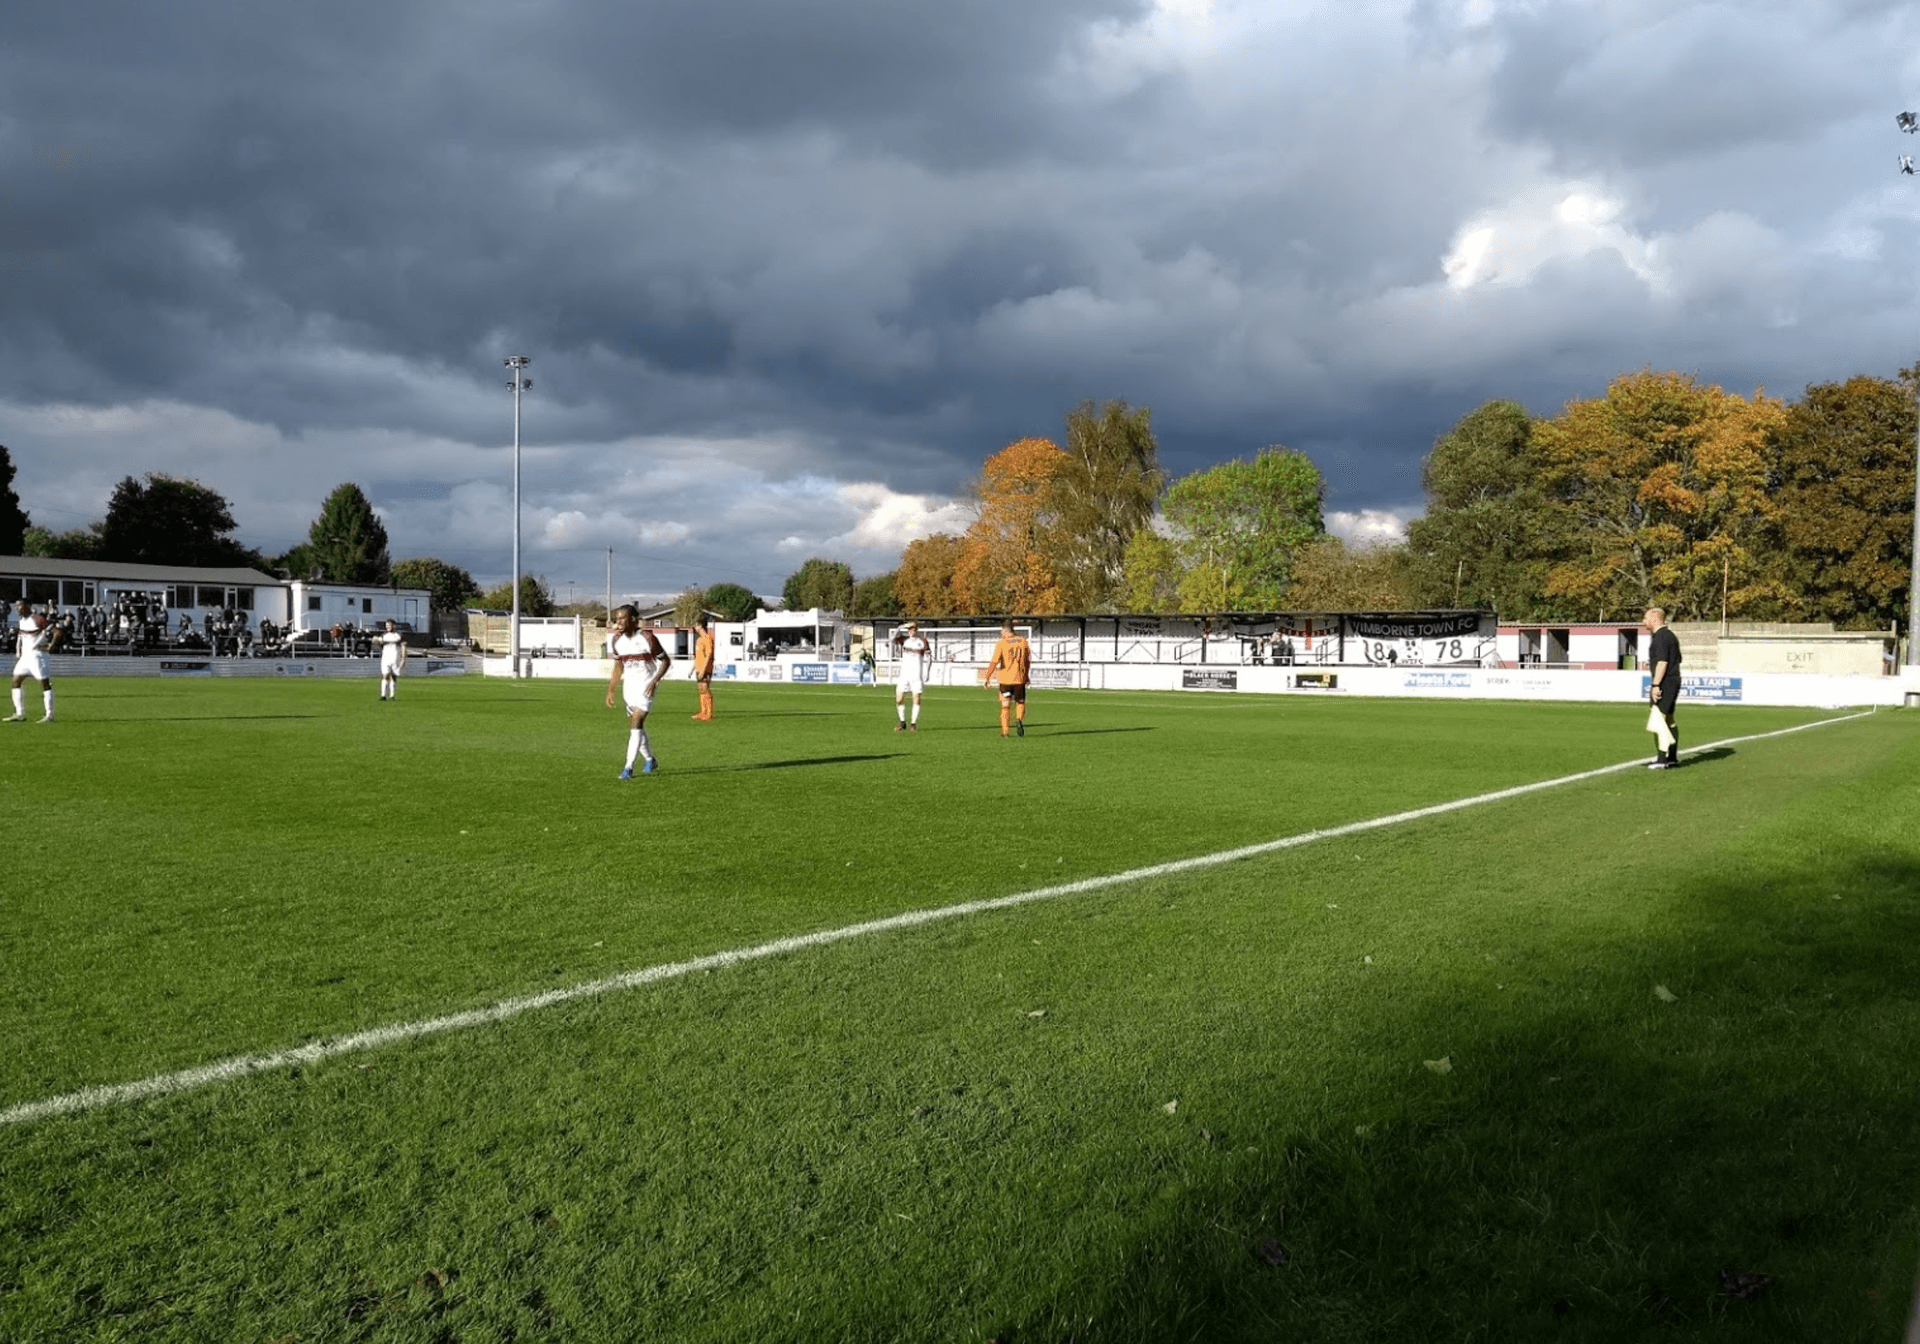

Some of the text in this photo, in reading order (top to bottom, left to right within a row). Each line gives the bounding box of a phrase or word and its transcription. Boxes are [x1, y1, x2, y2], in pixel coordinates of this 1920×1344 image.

[1419, 621, 1454, 635] TOWN
[1458, 617, 1474, 630] FC
[1435, 639, 1463, 661] 78
[1786, 652, 1814, 662] EXIT
